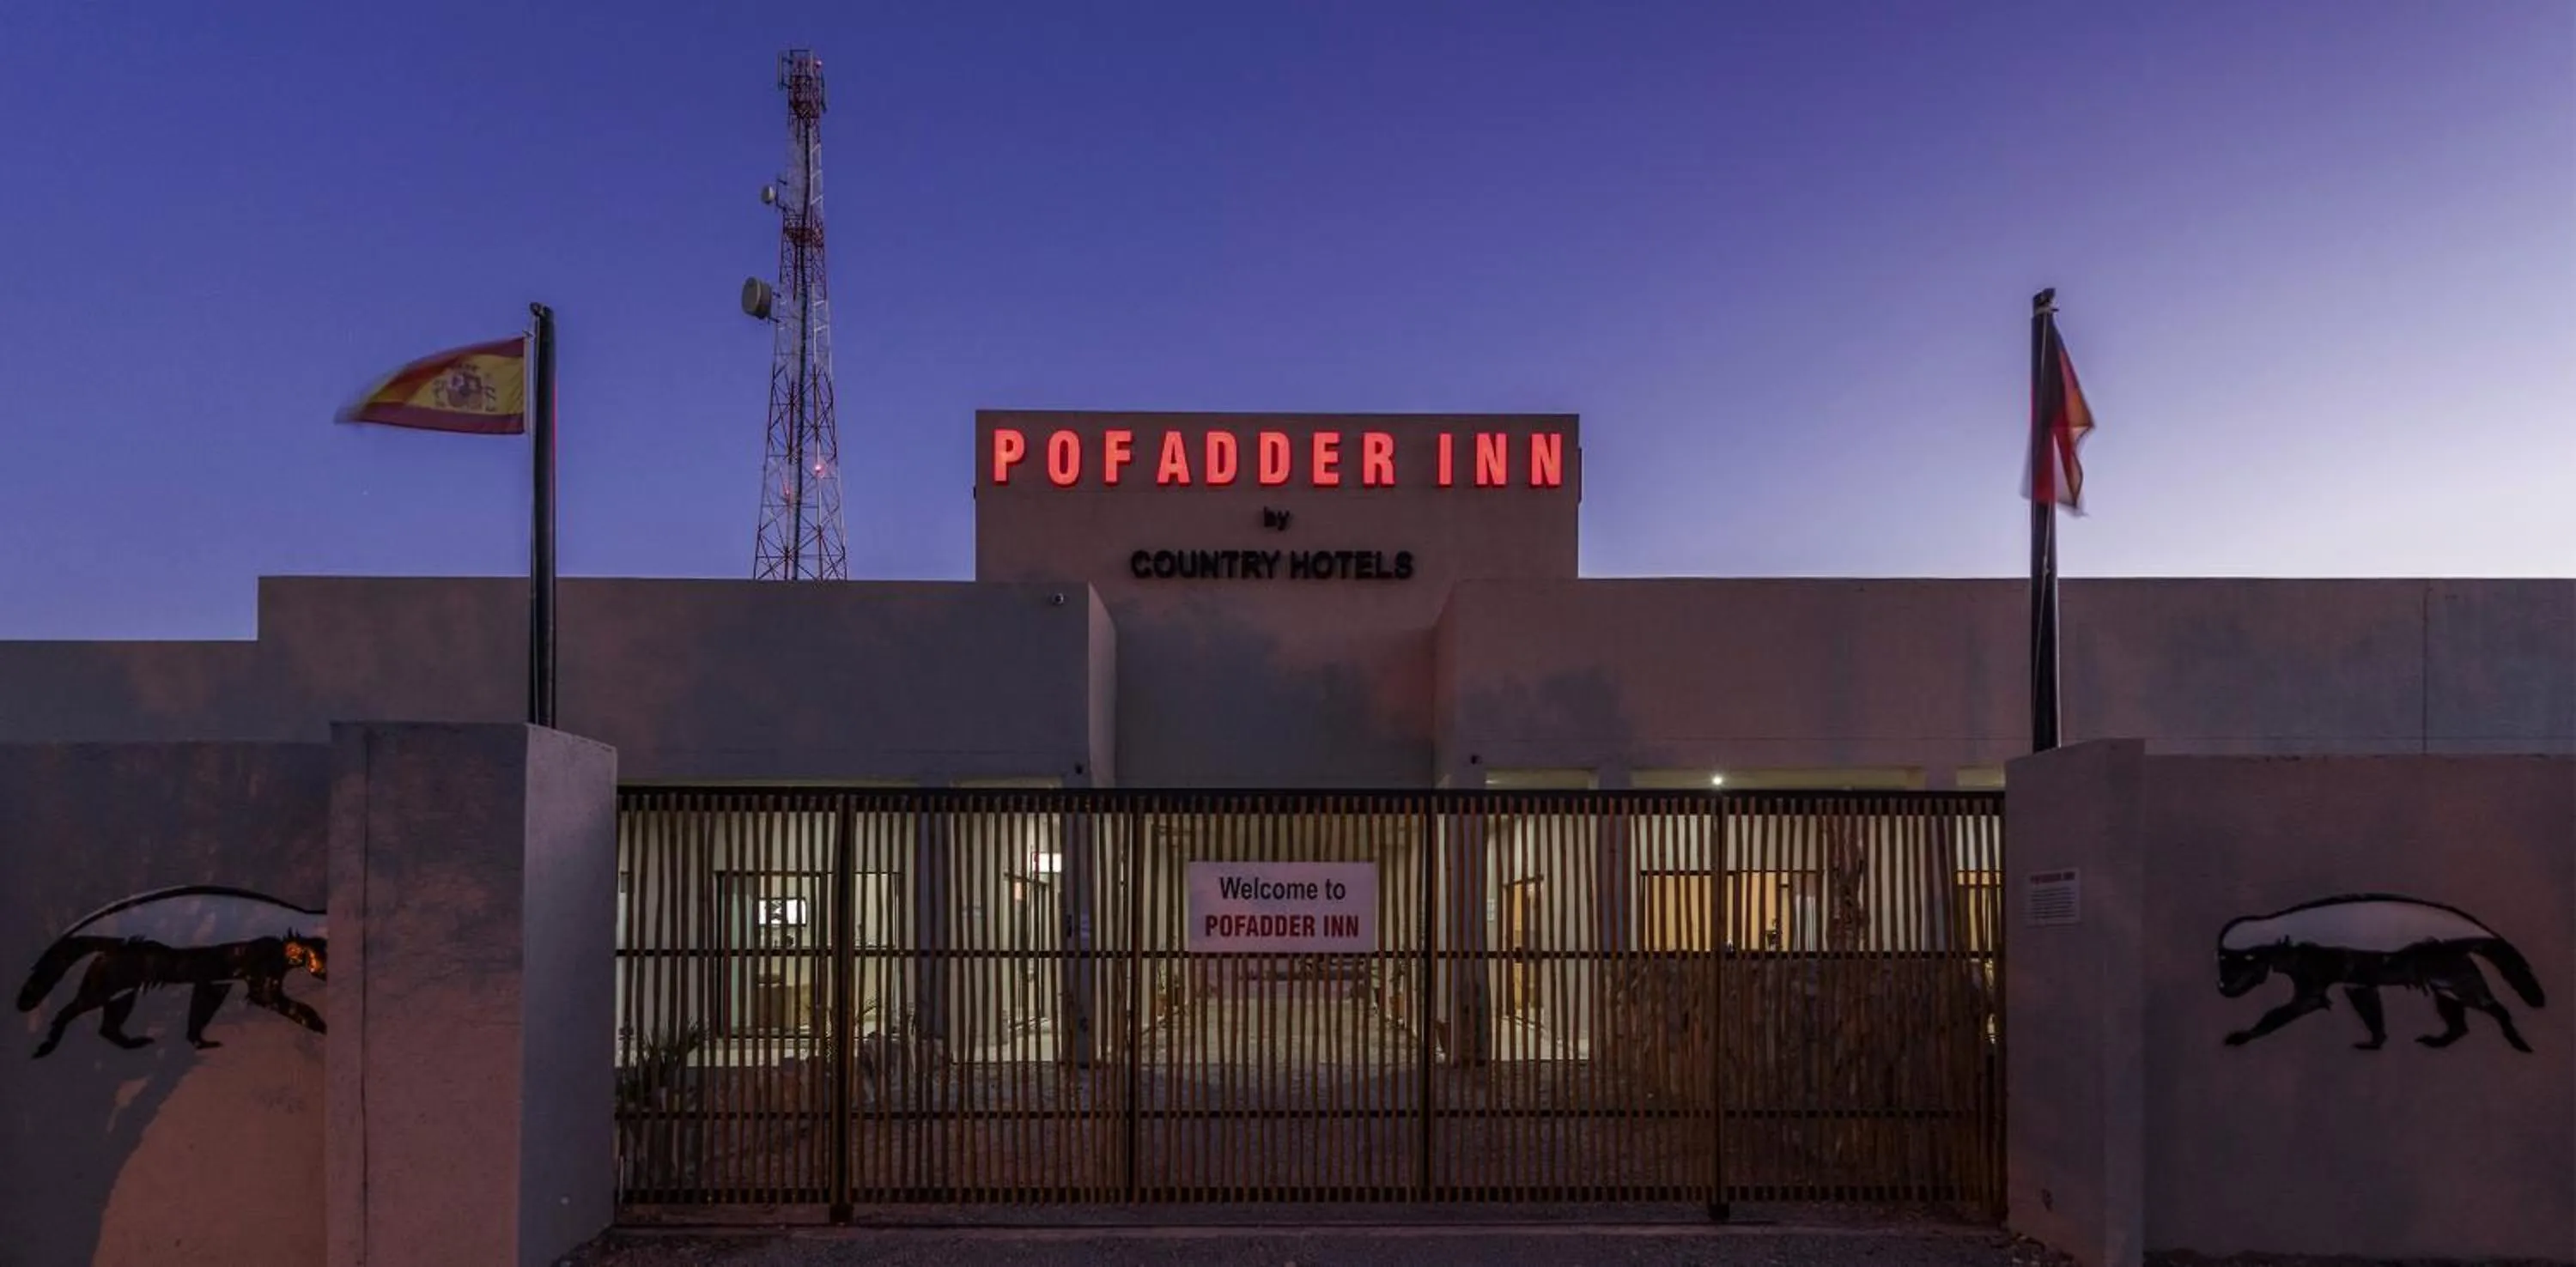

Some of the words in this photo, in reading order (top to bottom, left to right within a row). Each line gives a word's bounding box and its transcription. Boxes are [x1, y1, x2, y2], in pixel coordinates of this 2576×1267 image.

[993, 429, 1396, 487] POFADDER
[1437, 432, 1565, 488] INN
[1263, 506, 1291, 530] by
[1131, 550, 1280, 579] COUNTRY
[1291, 551, 1414, 579] HOTELS
[1219, 876, 1318, 900] Welcome
[1325, 878, 1346, 900] to
[1205, 914, 1315, 937] POFADDER
[1323, 914, 1360, 937] INN
